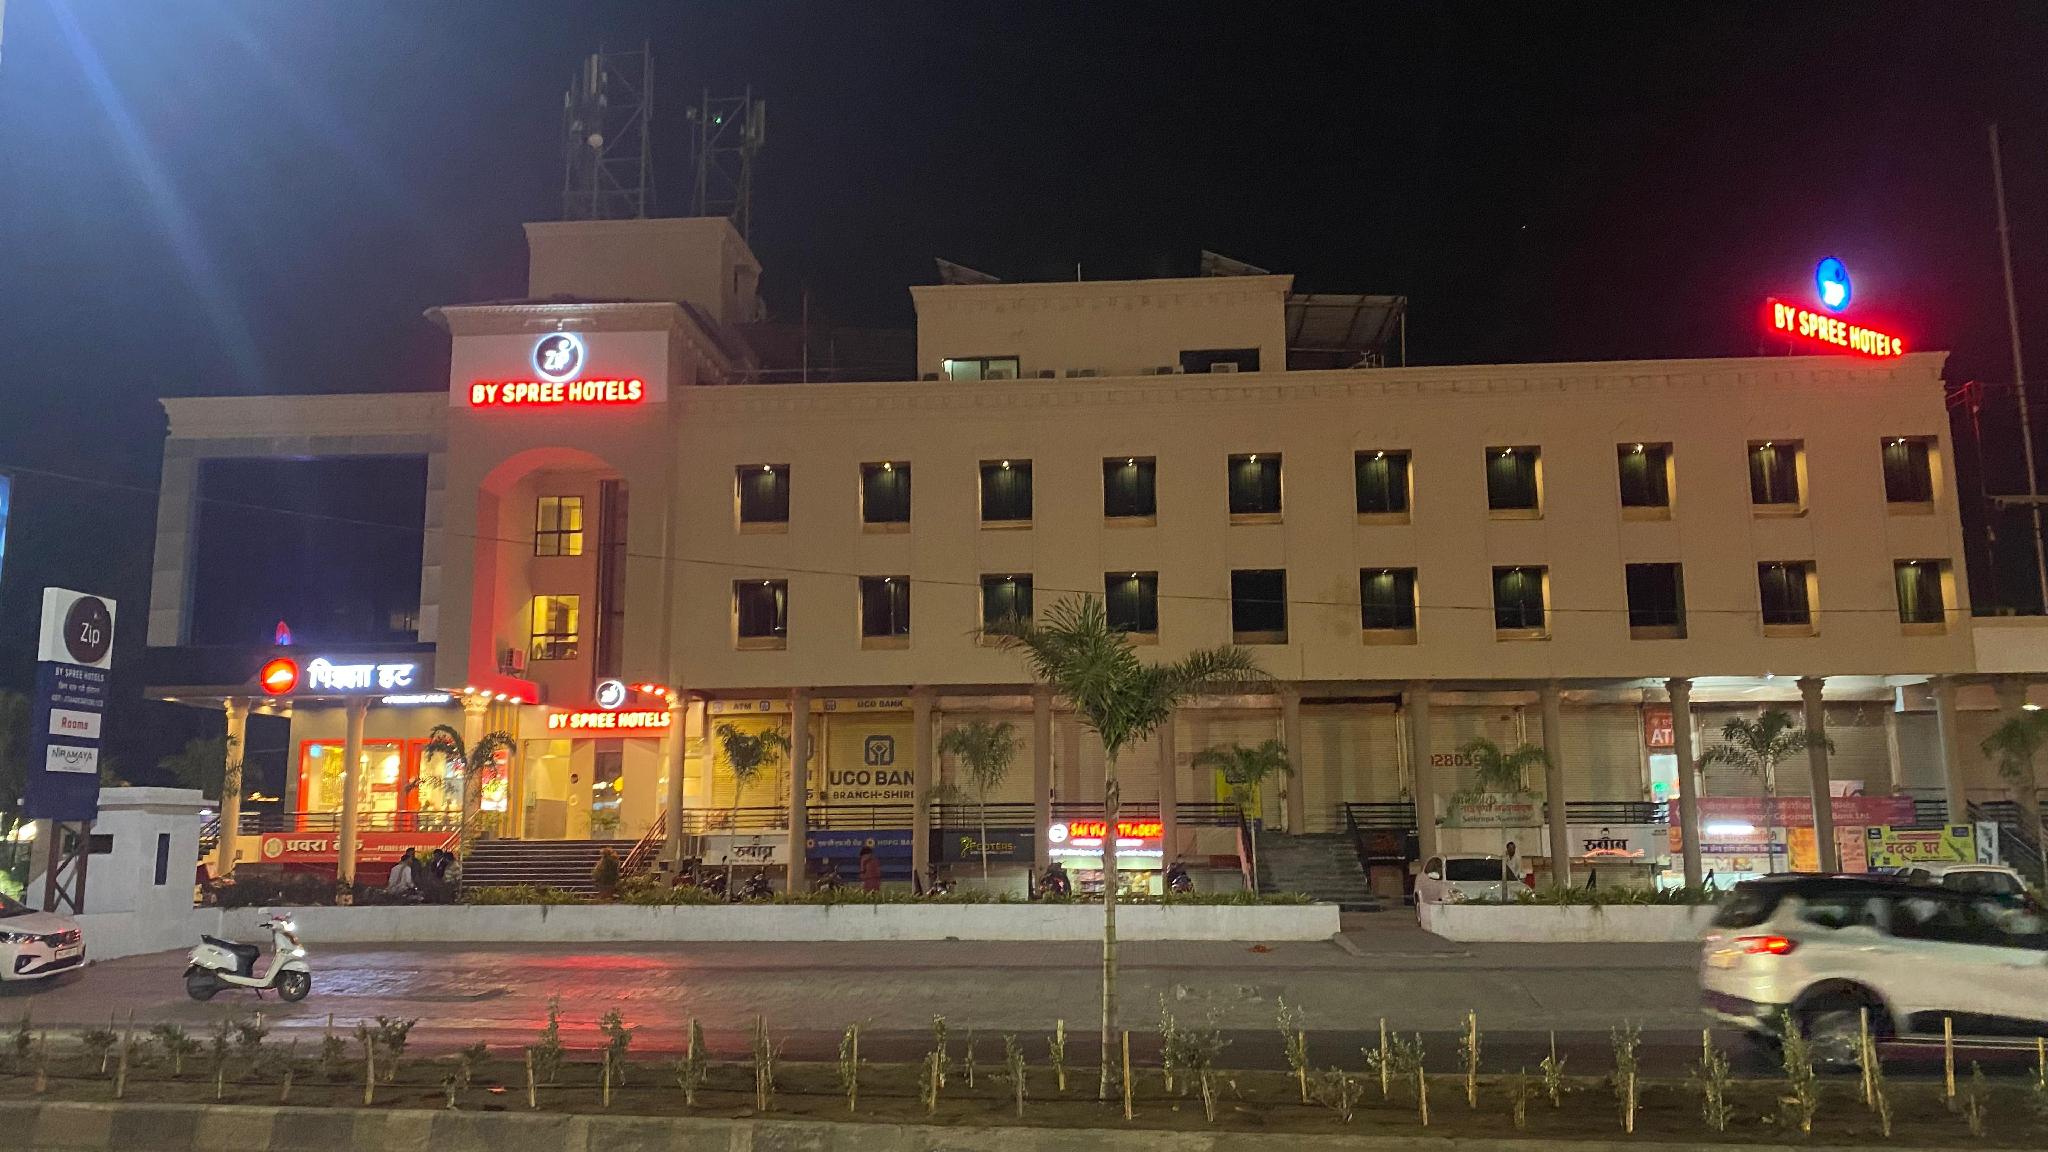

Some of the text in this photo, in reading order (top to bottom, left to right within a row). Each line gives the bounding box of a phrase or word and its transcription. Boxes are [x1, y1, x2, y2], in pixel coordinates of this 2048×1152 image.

[1774, 303, 1902, 356] BY SPREE HOTELS
[471, 380, 642, 404] BY SPREE HOTELS
[80, 622, 100, 648] Zip
[65, 668, 82, 679] SPREE
[879, 700, 904, 708] BANK
[61, 716, 89, 730] Rooms
[549, 712, 671, 728] BY SPREE HOTELS
[1651, 728, 1675, 744] AT
[829, 770, 871, 786] UCO
[875, 770, 914, 786] BAN
[833, 789, 914, 800] BRANCH-SHIR
[1070, 823, 1088, 837] SAI
[286, 840, 327, 853] प्रवरा
